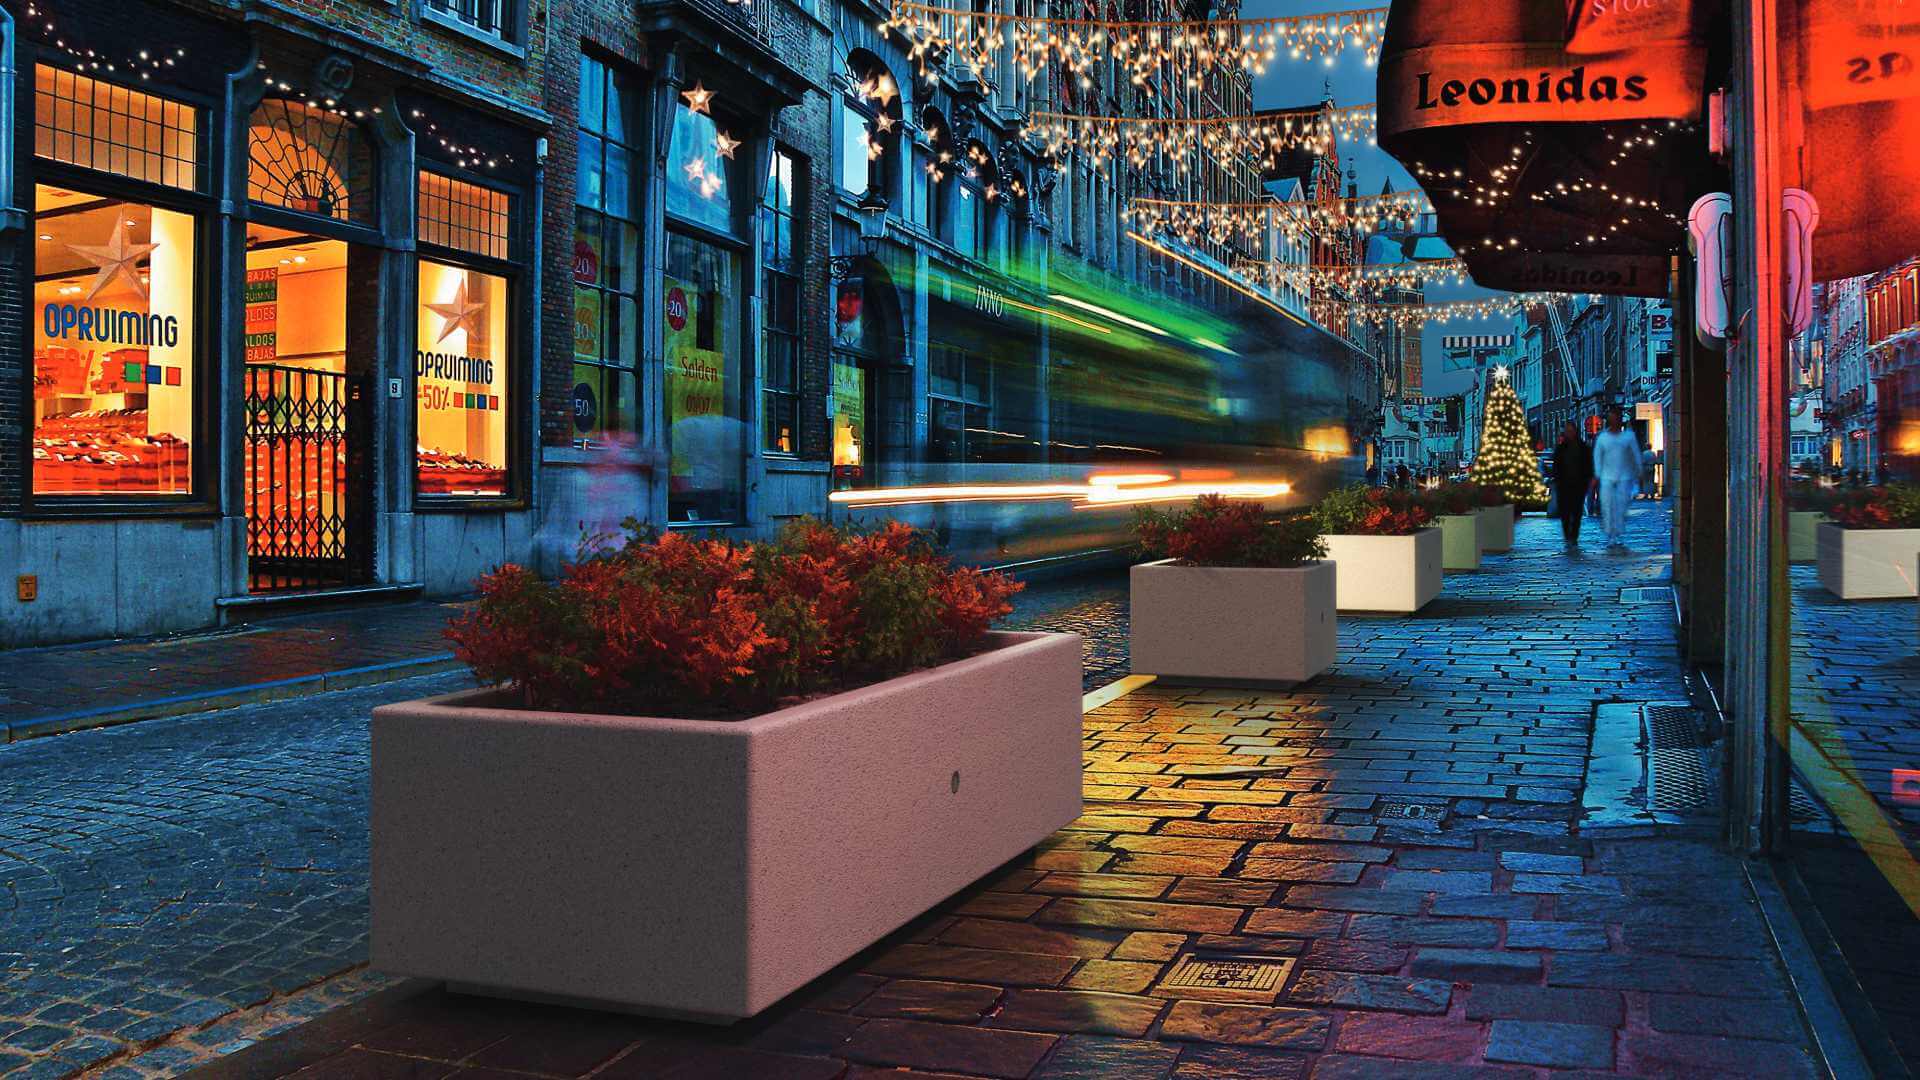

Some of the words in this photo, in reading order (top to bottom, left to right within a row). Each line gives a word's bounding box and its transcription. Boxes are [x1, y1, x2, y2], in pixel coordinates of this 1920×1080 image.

[1416, 67, 1648, 110] Leonidas
[976, 285, 1003, 317] INNO
[44, 303, 178, 348] OPRUIMING
[681, 356, 718, 383] Solden
